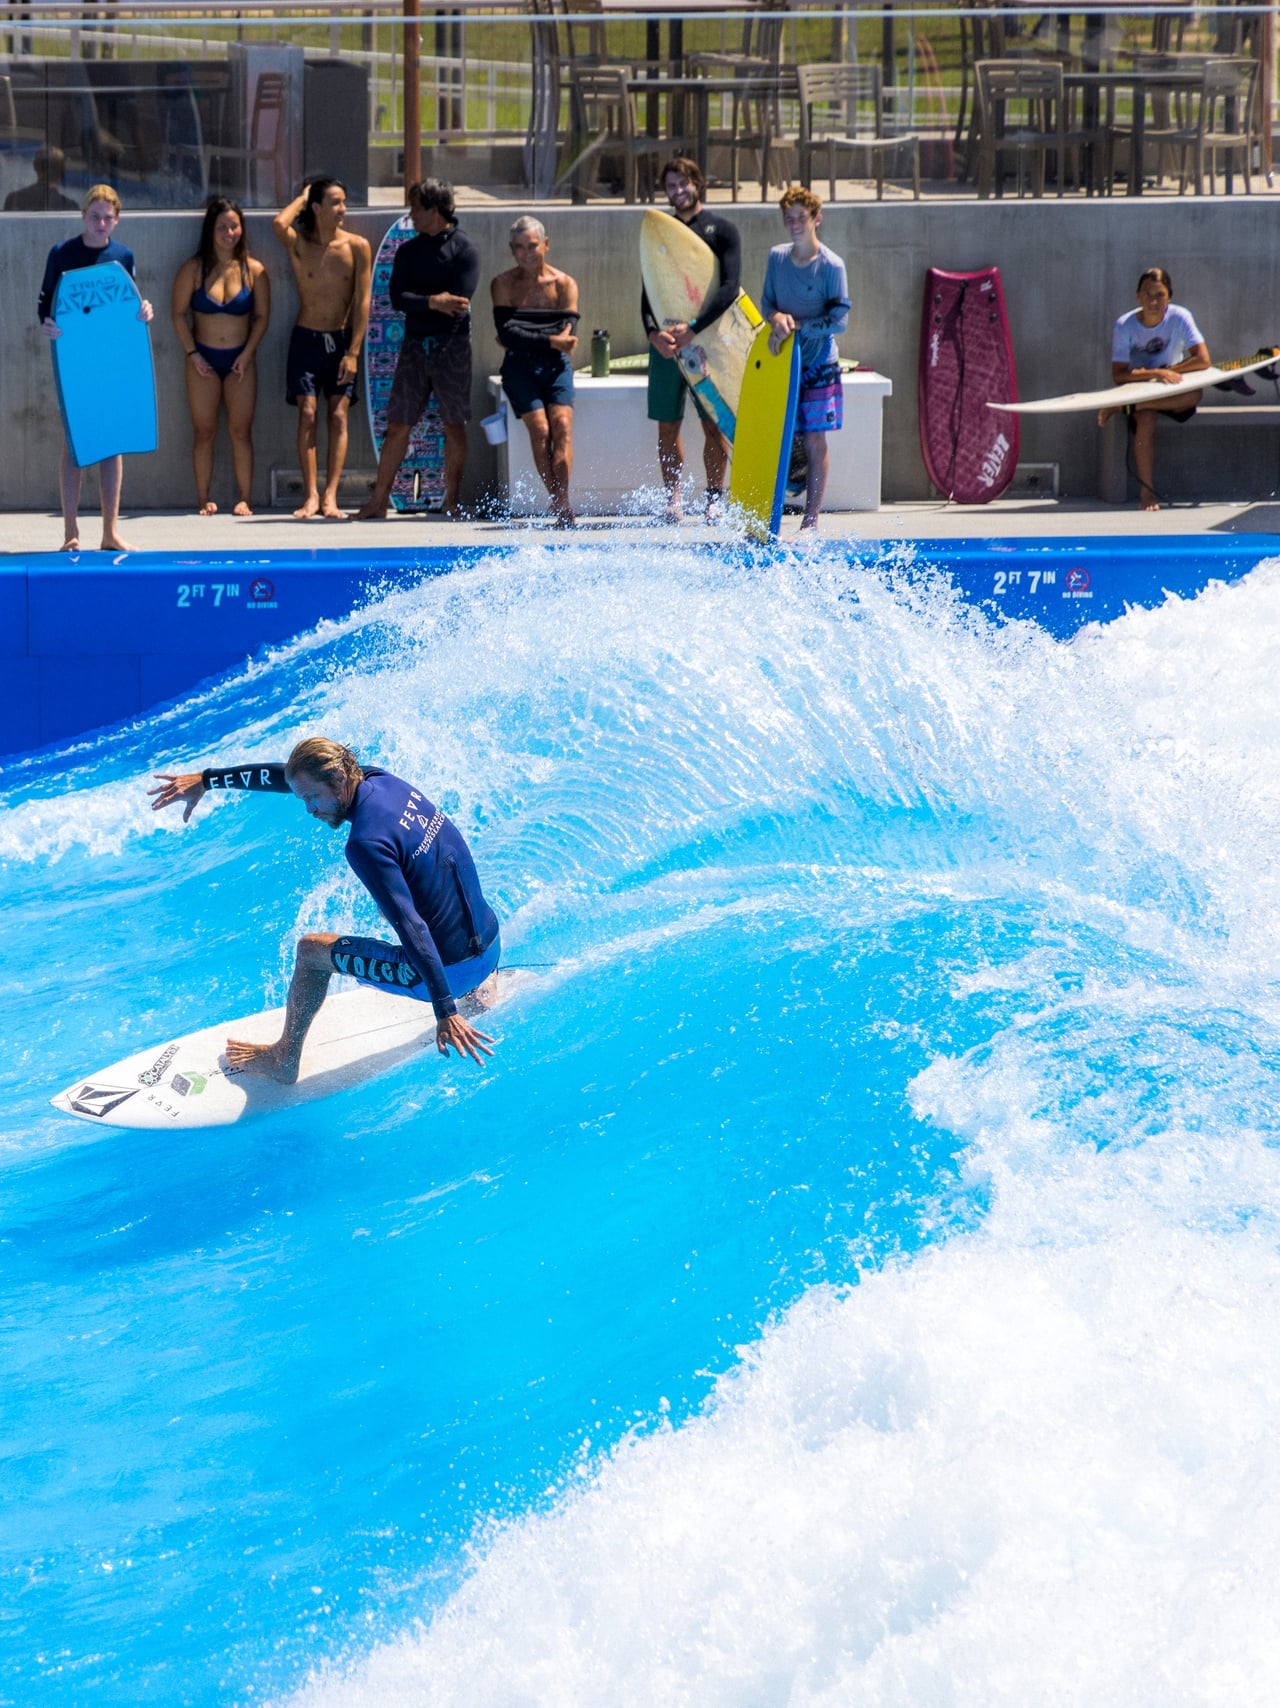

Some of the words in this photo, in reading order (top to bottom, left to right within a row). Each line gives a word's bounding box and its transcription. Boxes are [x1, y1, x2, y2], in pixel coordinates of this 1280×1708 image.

[70, 275, 116, 291] TRIAD
[976, 433, 1010, 488] BEATER
[399, 791, 422, 830] FEVR
